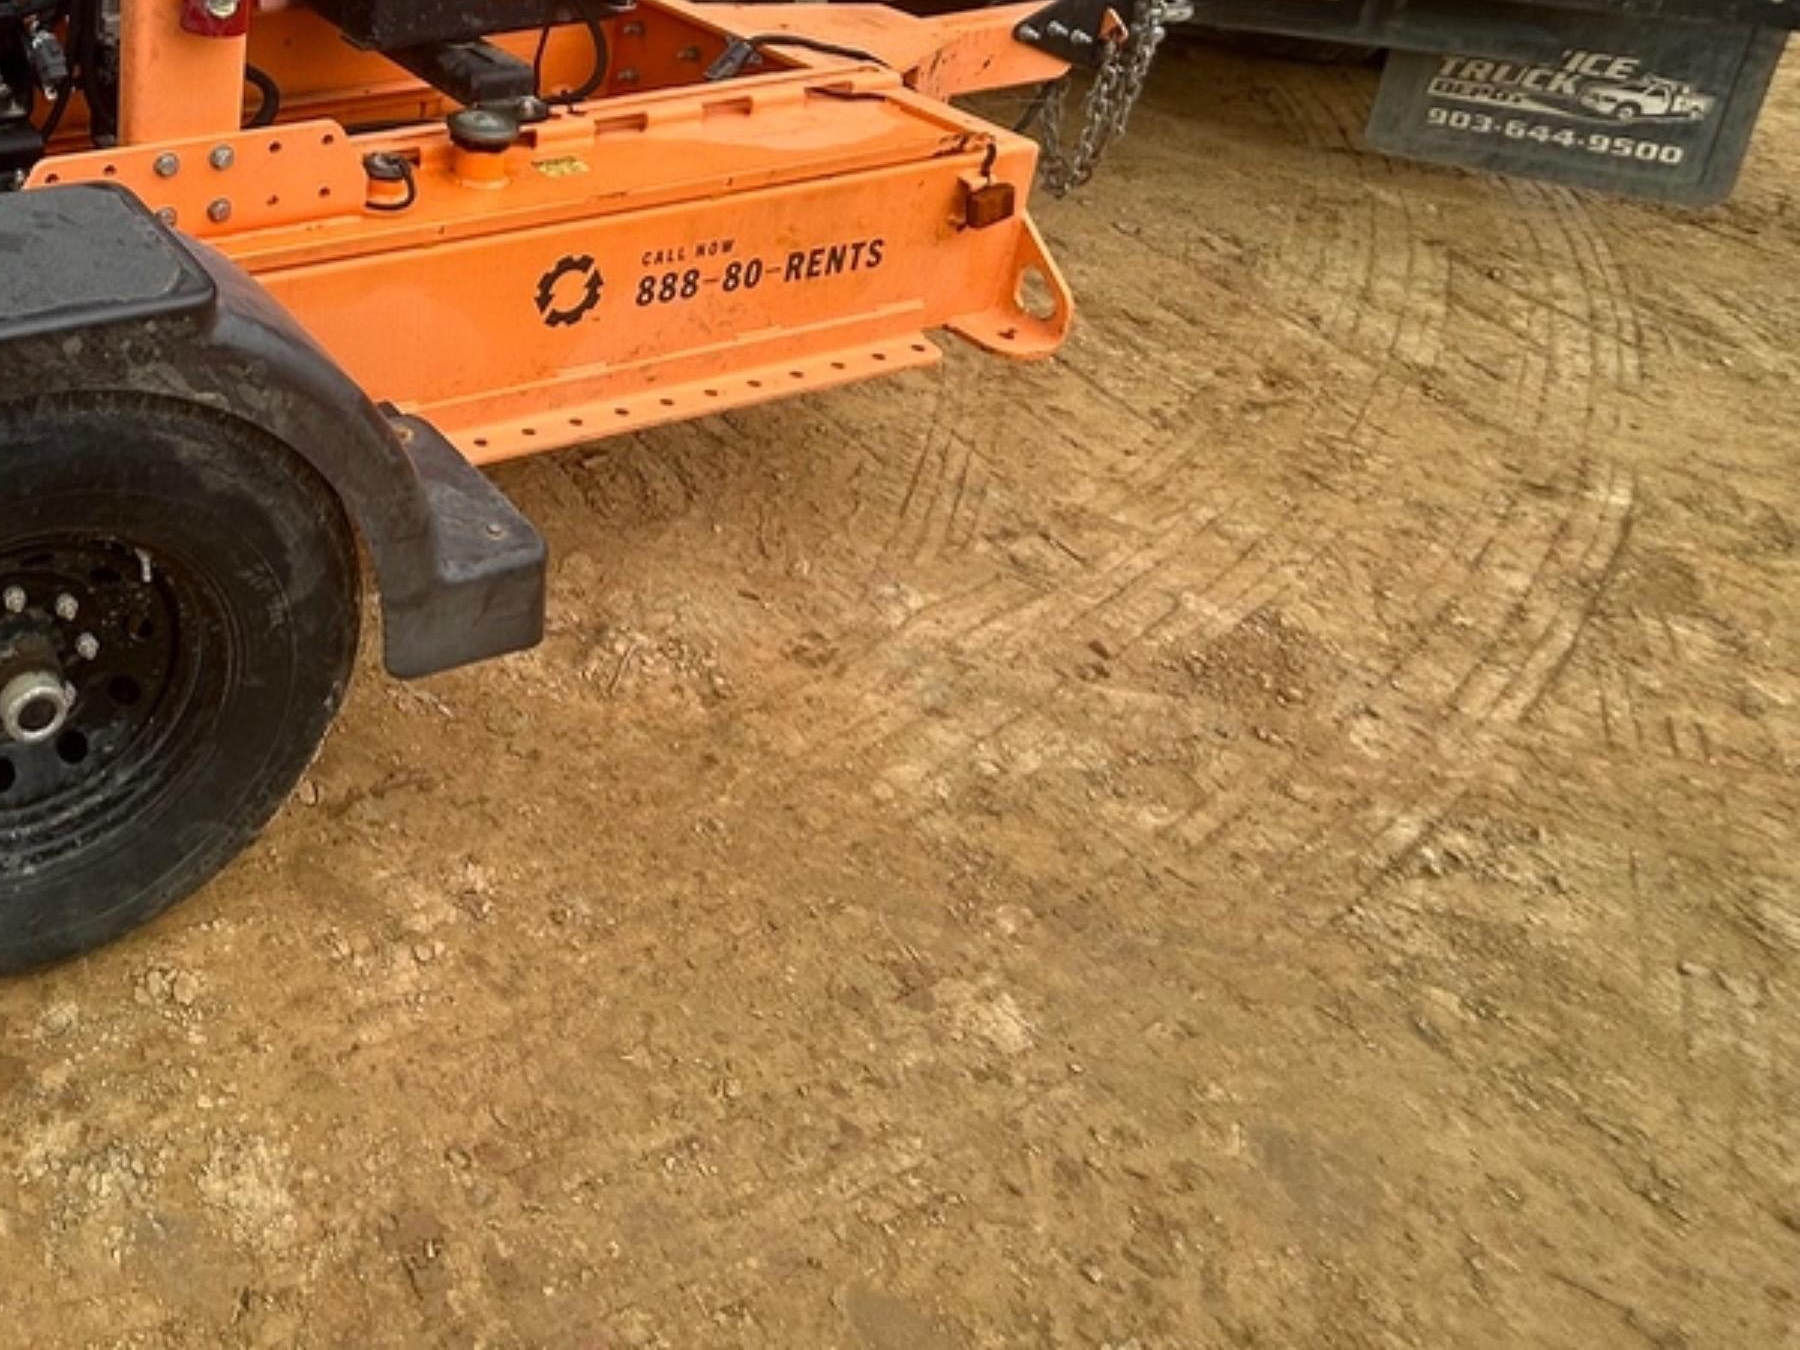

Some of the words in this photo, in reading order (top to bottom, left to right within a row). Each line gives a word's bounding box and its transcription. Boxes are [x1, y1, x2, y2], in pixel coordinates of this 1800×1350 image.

[1438, 55, 1583, 95] TRUCK
[635, 239, 885, 307] 888-80-RENTS
[641, 248, 686, 267] CALL
[694, 239, 736, 258] NOW
